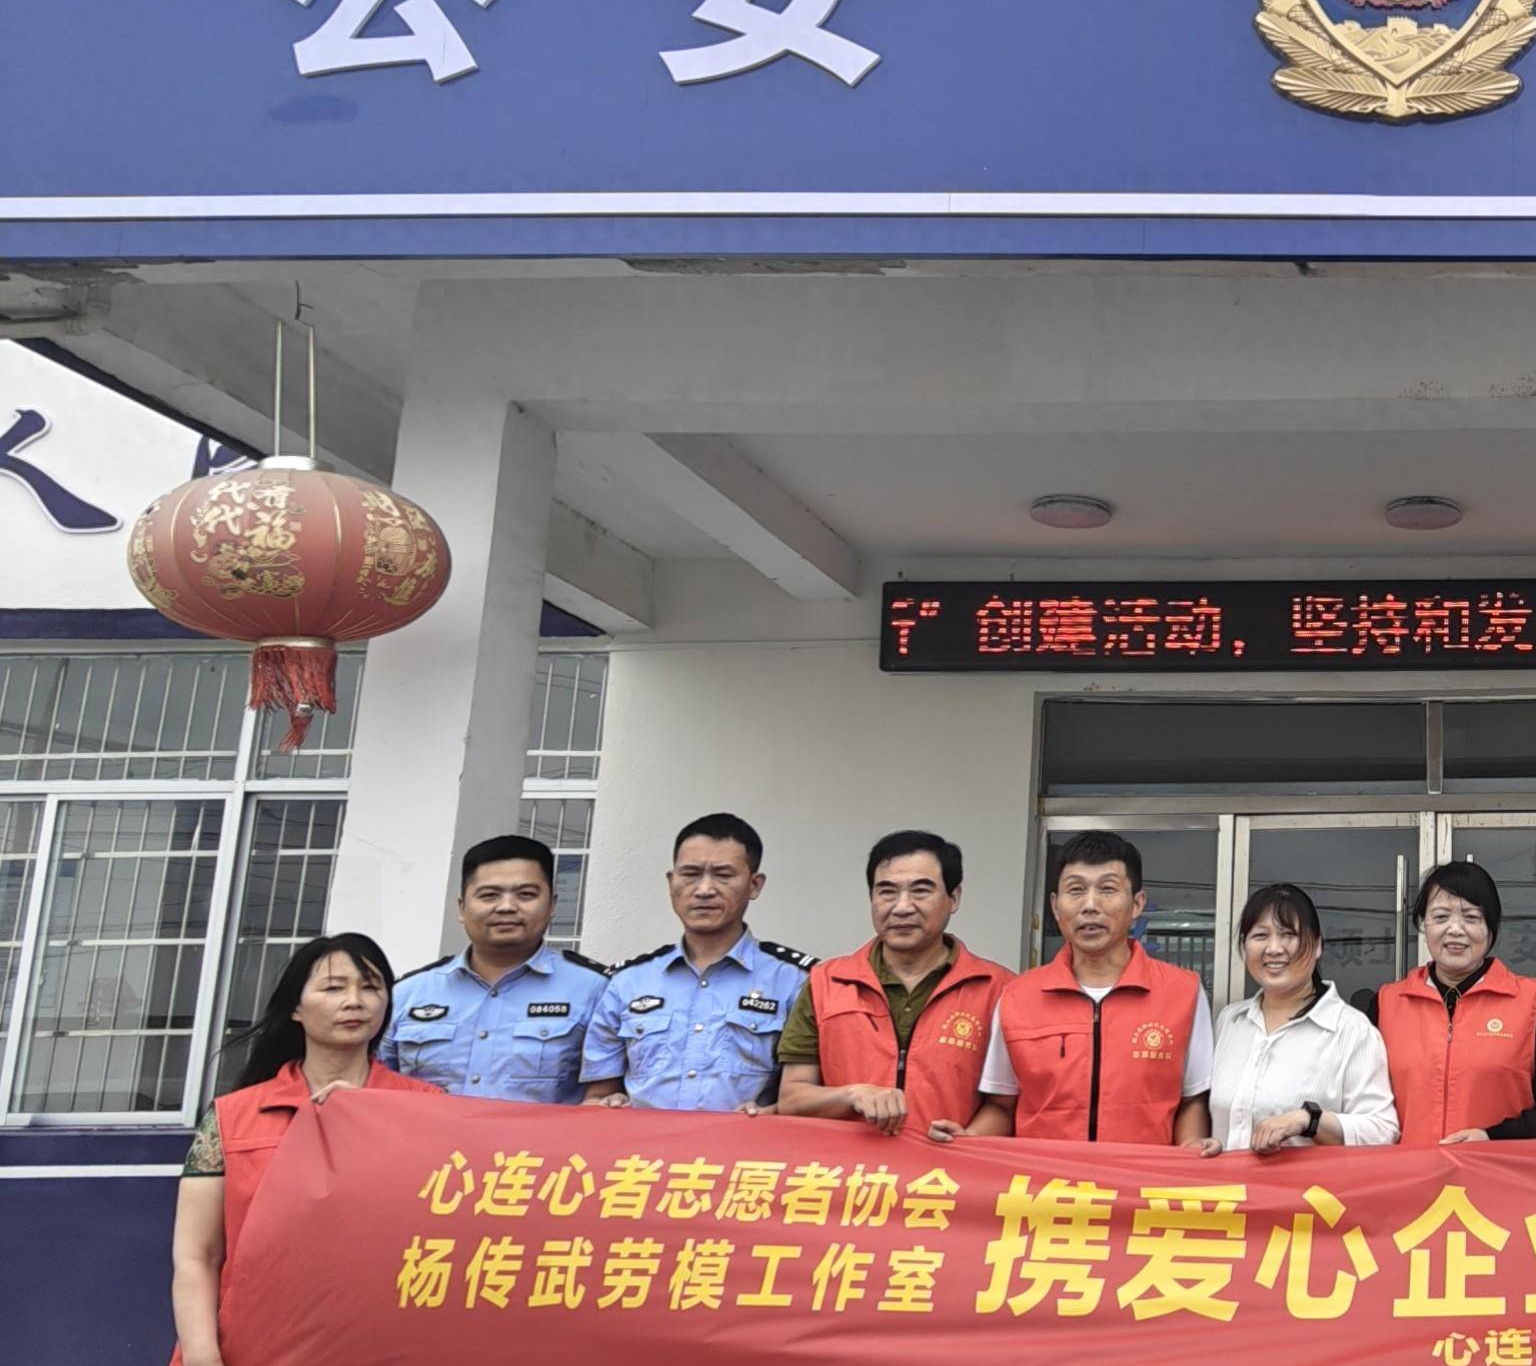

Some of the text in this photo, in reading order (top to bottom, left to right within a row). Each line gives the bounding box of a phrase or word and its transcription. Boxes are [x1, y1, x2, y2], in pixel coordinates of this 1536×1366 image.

[418, 1150, 962, 1232] 心连心者志愿者协会
[396, 1235, 946, 1313] 杨传武劳模工作室
